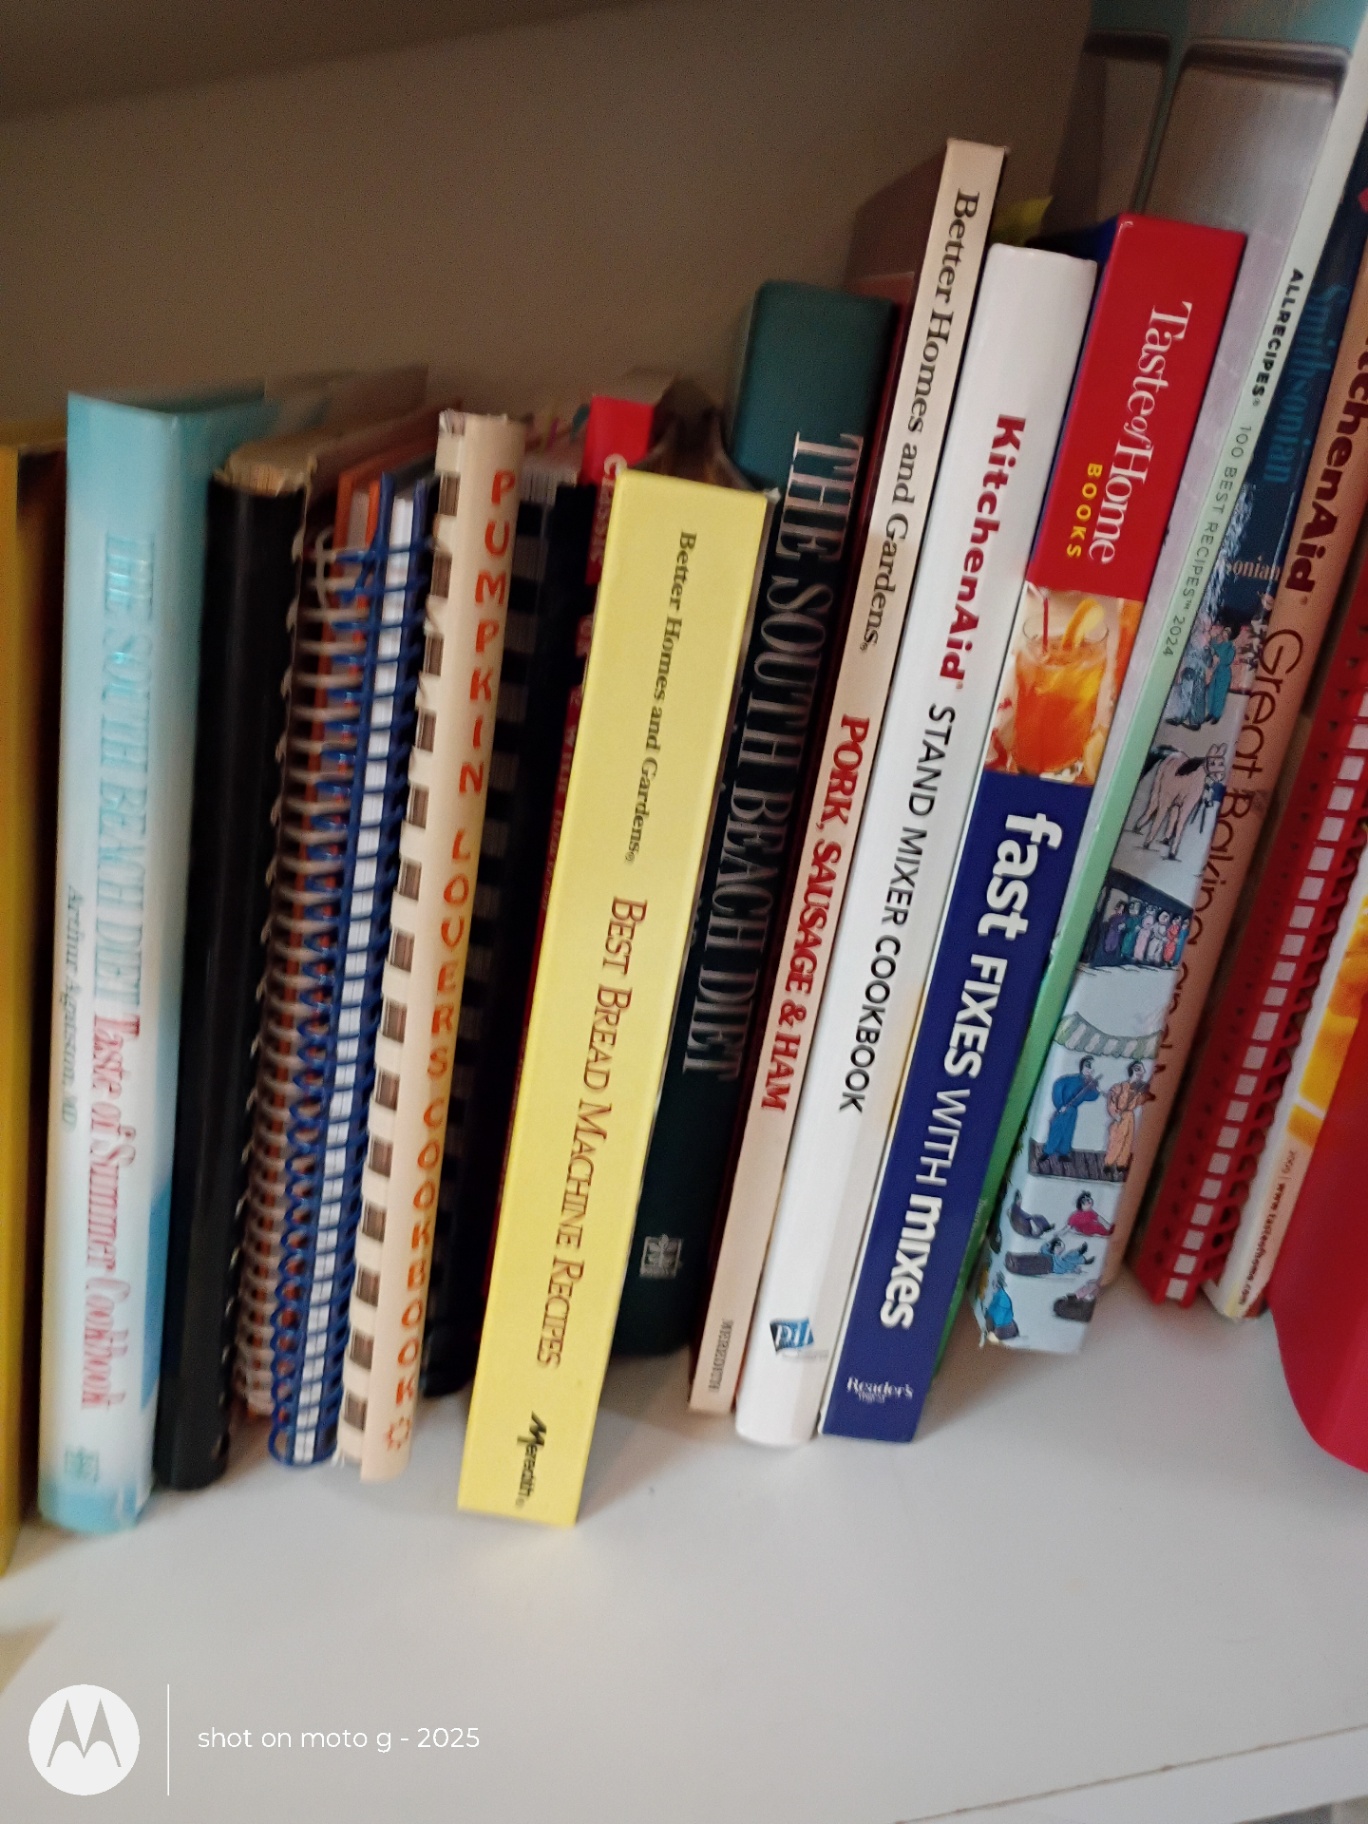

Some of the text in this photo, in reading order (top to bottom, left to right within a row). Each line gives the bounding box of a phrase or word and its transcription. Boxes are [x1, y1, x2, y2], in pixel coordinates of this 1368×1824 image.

[933, 187, 980, 305] Better
[908, 308, 955, 433] Homes
[1089, 301, 1193, 565] Taste of Home
[1263, 283, 1350, 484] Smithsonian
[892, 442, 918, 504] and
[1212, 466, 1237, 515] BEST
[1231, 426, 1252, 458] 100
[1285, 336, 1368, 593] chenAid
[669, 531, 697, 612] Better
[940, 413, 1026, 682] KitchenAid
[1066, 462, 1103, 558] BOOKS
[458, 468, 516, 796] PUMPKIN
[653, 615, 682, 702] Homes
[1162, 615, 1186, 657] 2024
[94, 528, 154, 1007] THE SOUTH BEACH DIET
[645, 704, 663, 752] and
[683, 431, 865, 1082] THE SOUTH BEACH DIET
[761, 713, 870, 1113] PORK, SAUSAGE & HAM
[839, 703, 956, 1113] STAND MIXER COOKBOOK
[977, 813, 1063, 940] fast
[944, 954, 1008, 1078] FIXES
[536, 896, 648, 1371] BEST BREAD MACHINE RECIPES
[916, 1089, 970, 1187] WITH
[81, 1012, 140, 1411] Taste of Summer Cookbook
[395, 1098, 445, 1406] COOKBOOK
